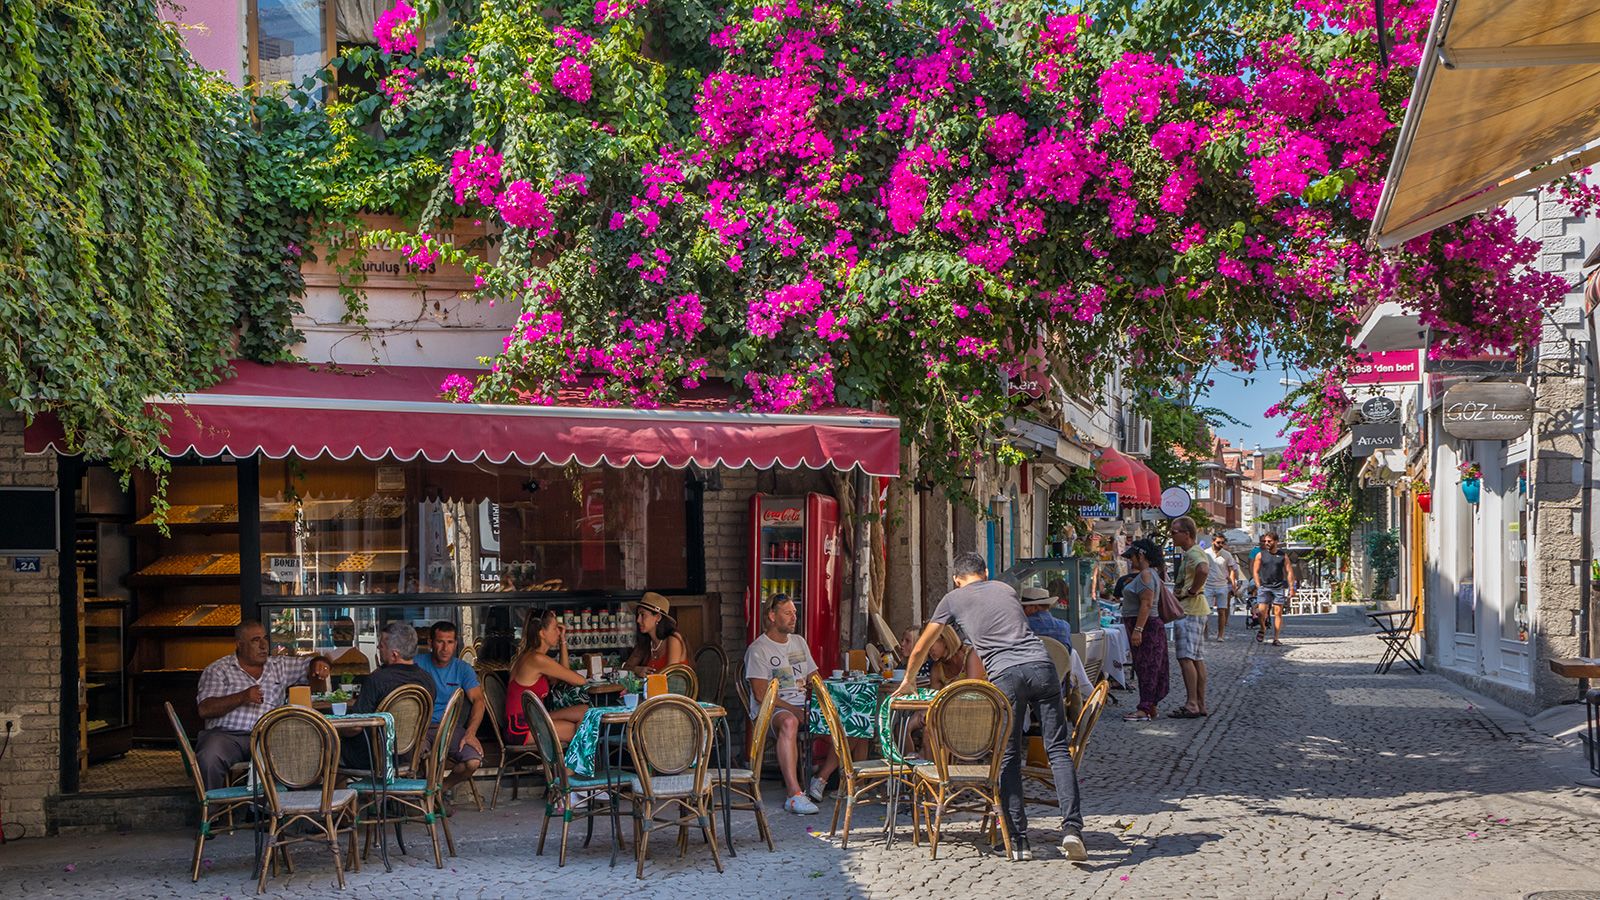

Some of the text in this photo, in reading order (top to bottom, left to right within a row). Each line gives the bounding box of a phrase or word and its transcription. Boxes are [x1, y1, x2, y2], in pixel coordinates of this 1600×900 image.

[357, 261, 436, 274] uruluş 13
[1357, 436, 1395, 446] ATASAY
[20, 562, 36, 571] 2A
